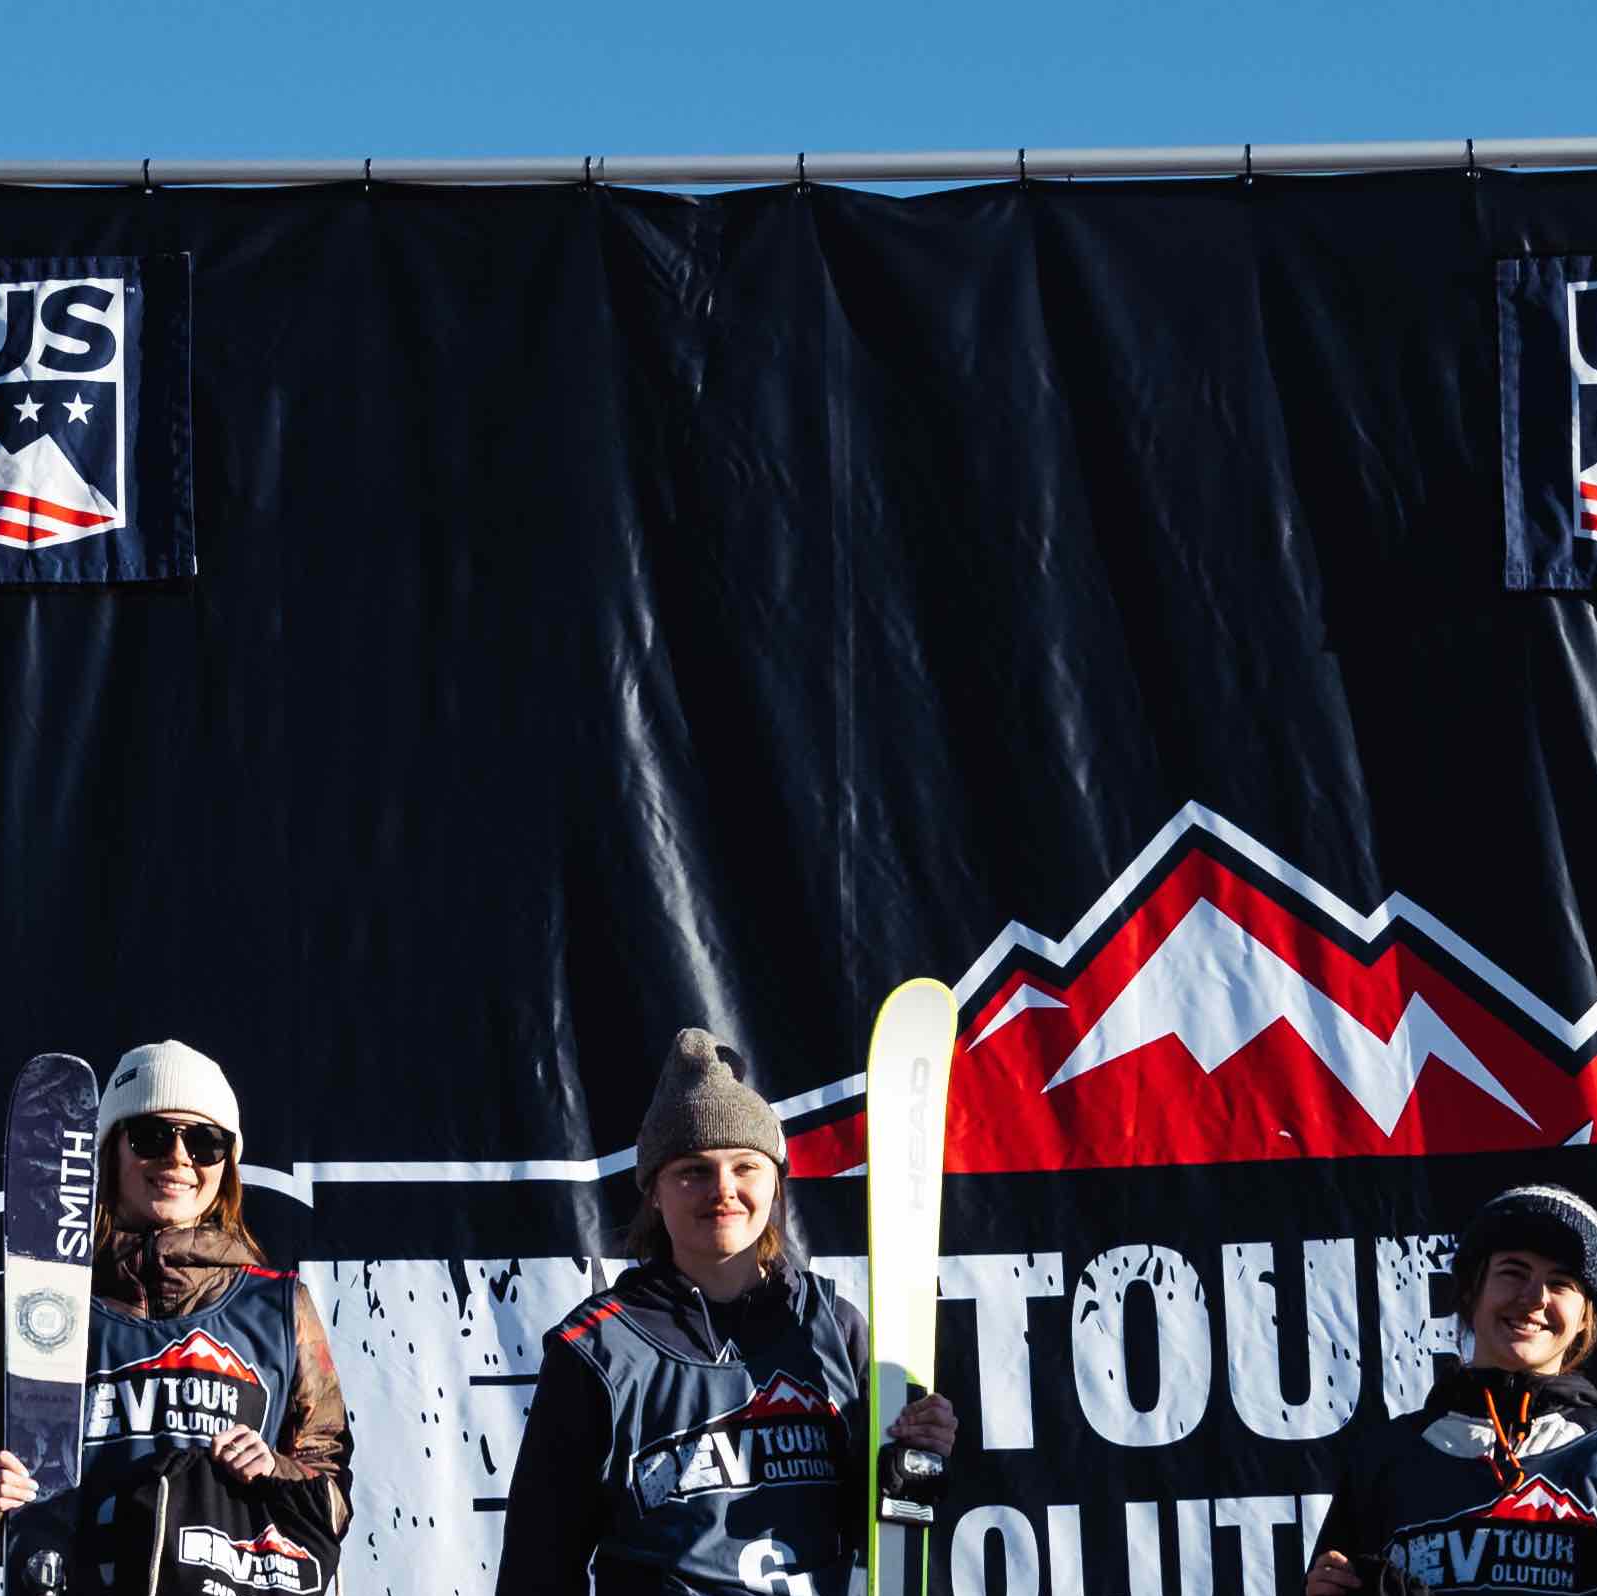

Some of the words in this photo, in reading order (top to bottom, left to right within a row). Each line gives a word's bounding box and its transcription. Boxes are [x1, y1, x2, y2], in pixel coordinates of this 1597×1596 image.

[908, 1057, 931, 1212] HEAD
[57, 1130, 94, 1259] SMITH
[85, 1377, 161, 1438] EV
[162, 1376, 239, 1415] TOUR
[756, 1424, 829, 1455] TOUR
[763, 1456, 836, 1479] OLUTION
[1491, 1528, 1575, 1563] TOUR
[252, 1553, 300, 1577] TOUR
[1491, 1563, 1574, 1589] OLUTION
